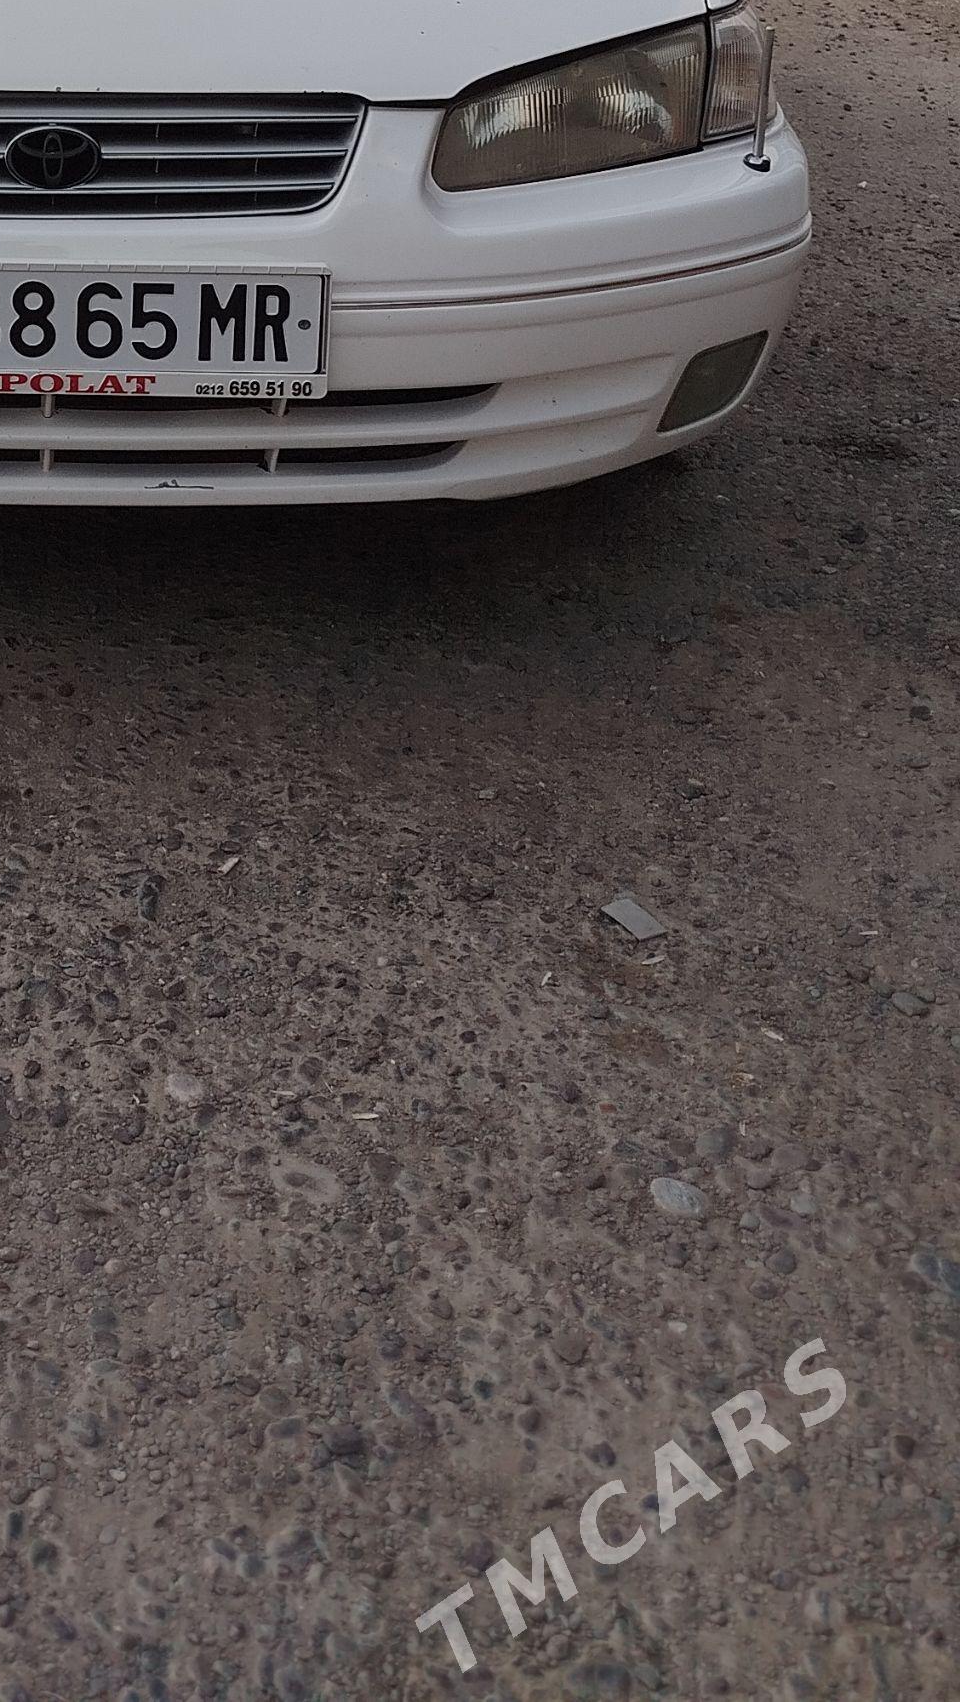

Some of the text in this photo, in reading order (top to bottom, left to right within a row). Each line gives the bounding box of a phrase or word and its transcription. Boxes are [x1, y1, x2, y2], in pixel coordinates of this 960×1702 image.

[197, 283, 291, 363] MR
[195, 381, 313, 397] 0212 659 51 90
